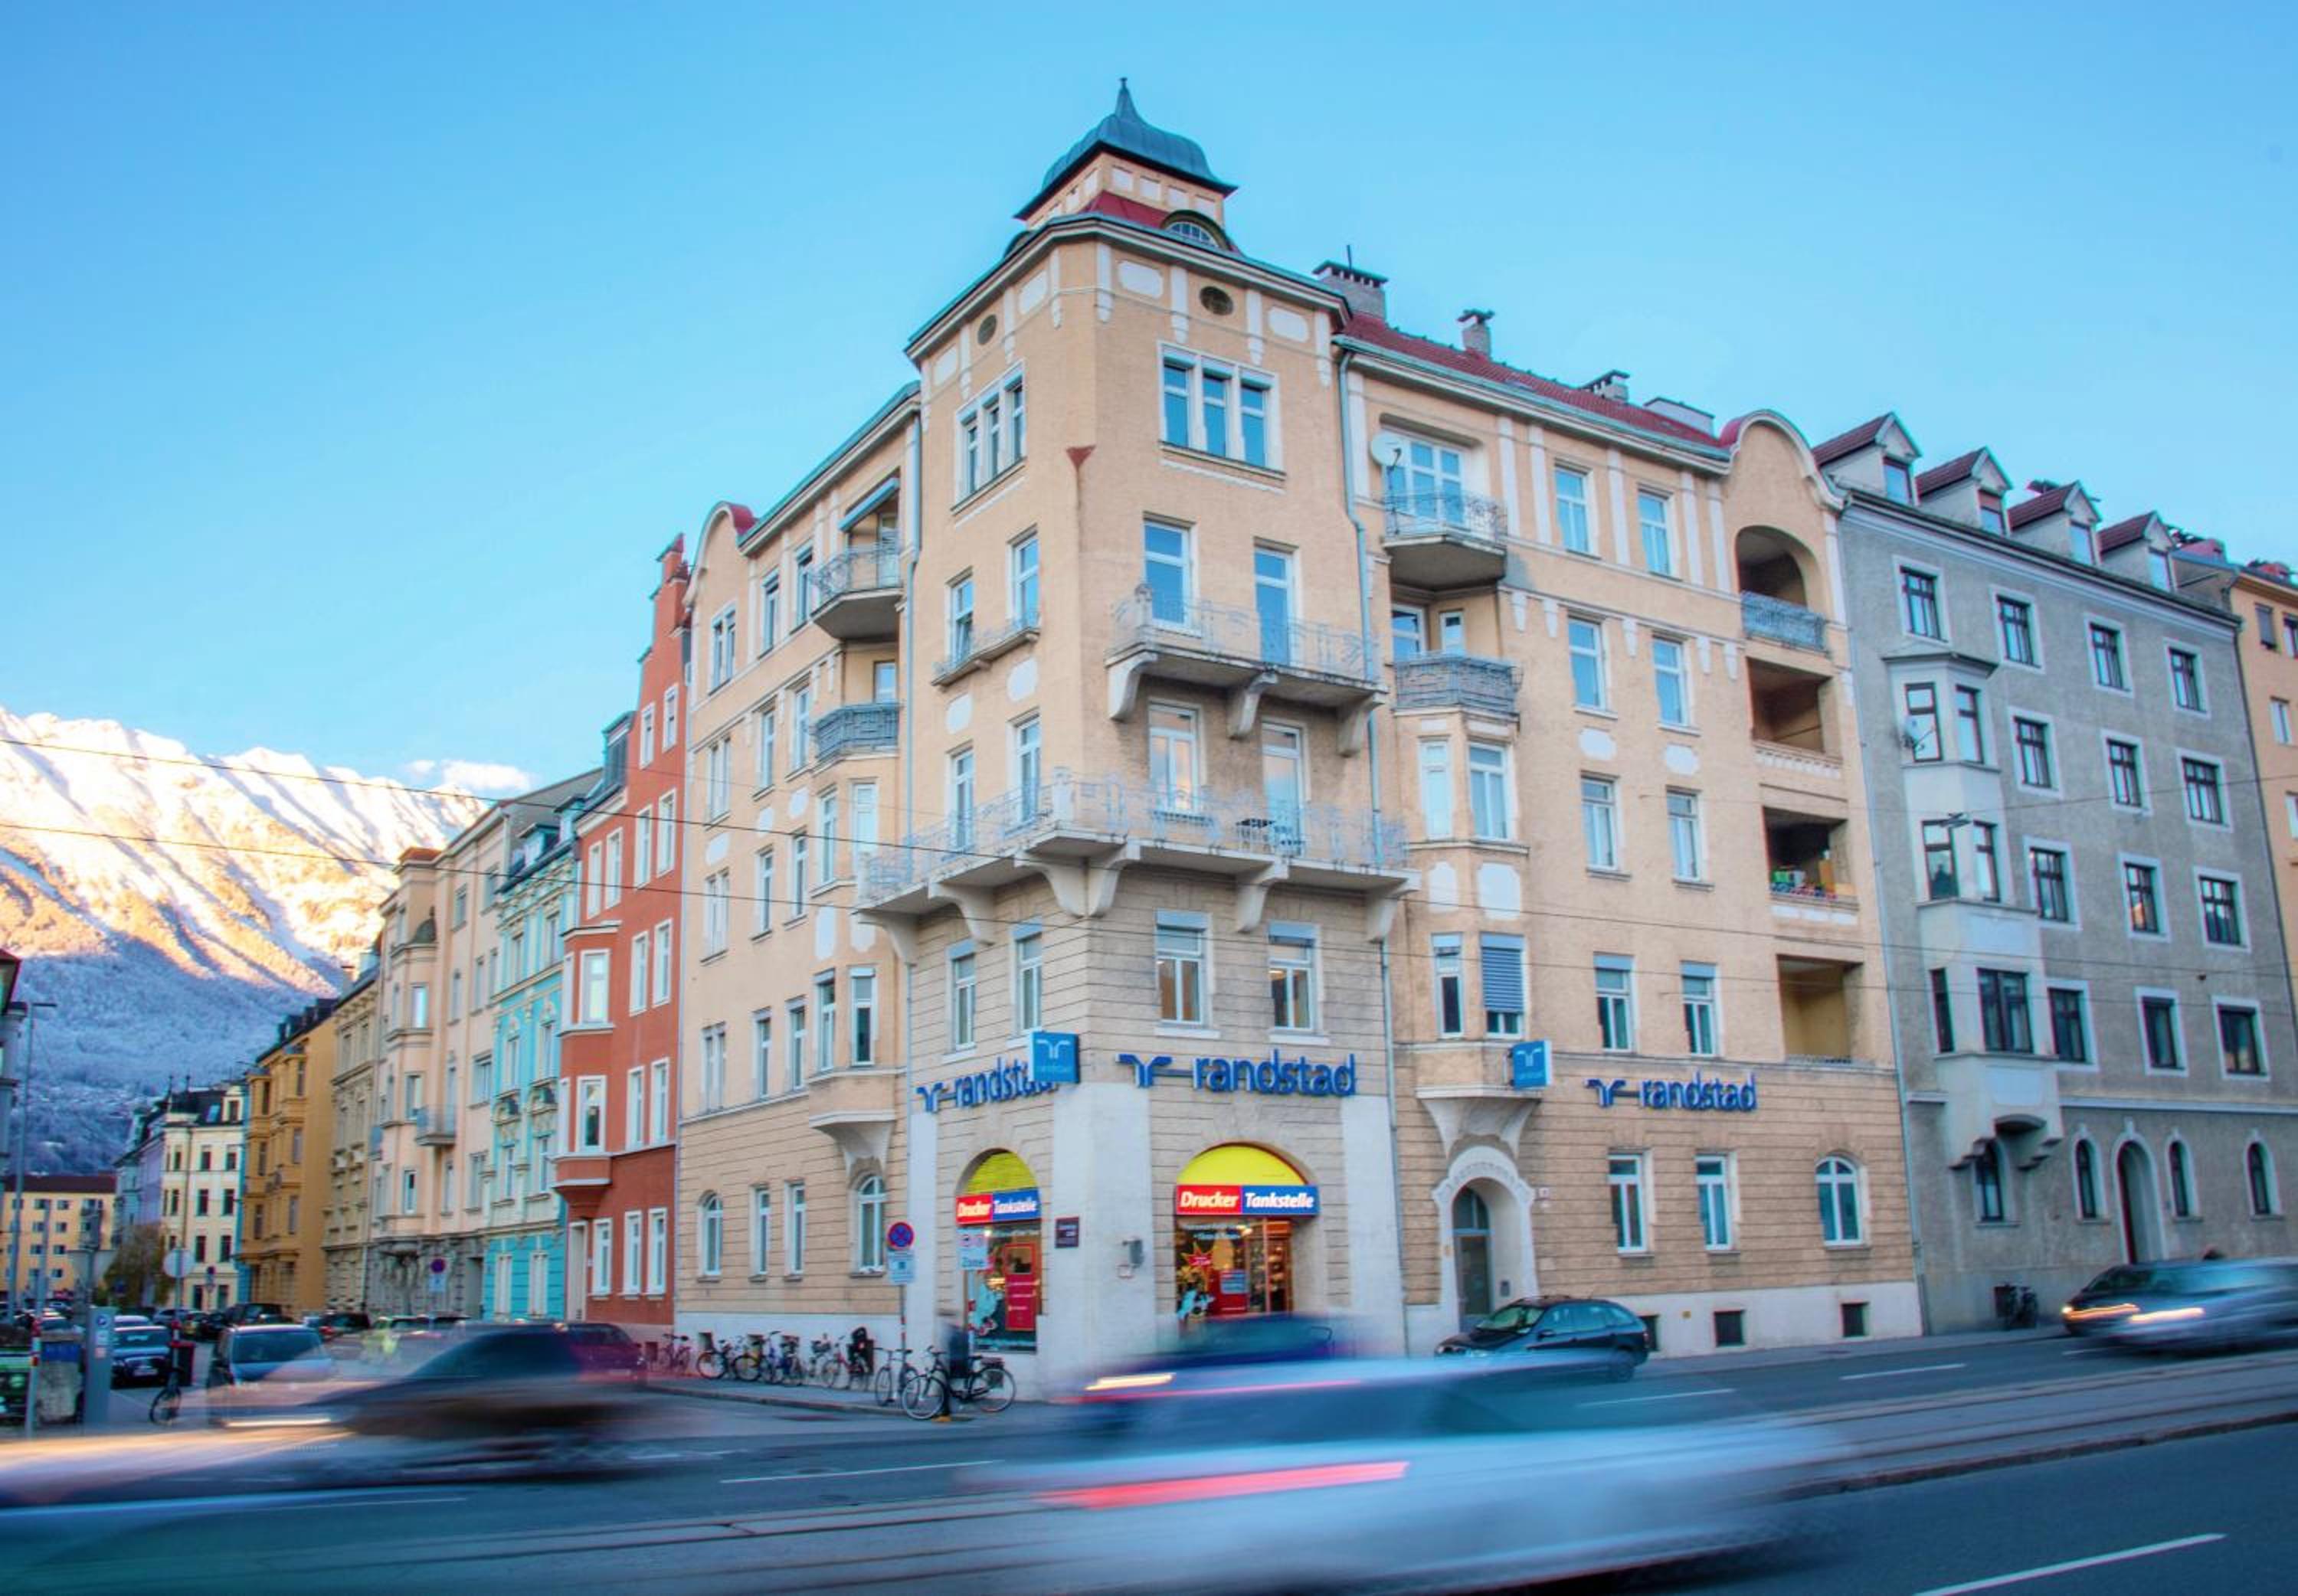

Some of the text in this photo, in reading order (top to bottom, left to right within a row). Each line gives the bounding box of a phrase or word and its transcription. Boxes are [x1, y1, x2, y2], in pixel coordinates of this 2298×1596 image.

[1193, 1048, 1356, 1096] randstad
[1640, 1071, 1758, 1110] randstad
[958, 1196, 1037, 1217] Drucker Tankstelle
[1180, 1191, 1314, 1208] Drucker Tankstelle
